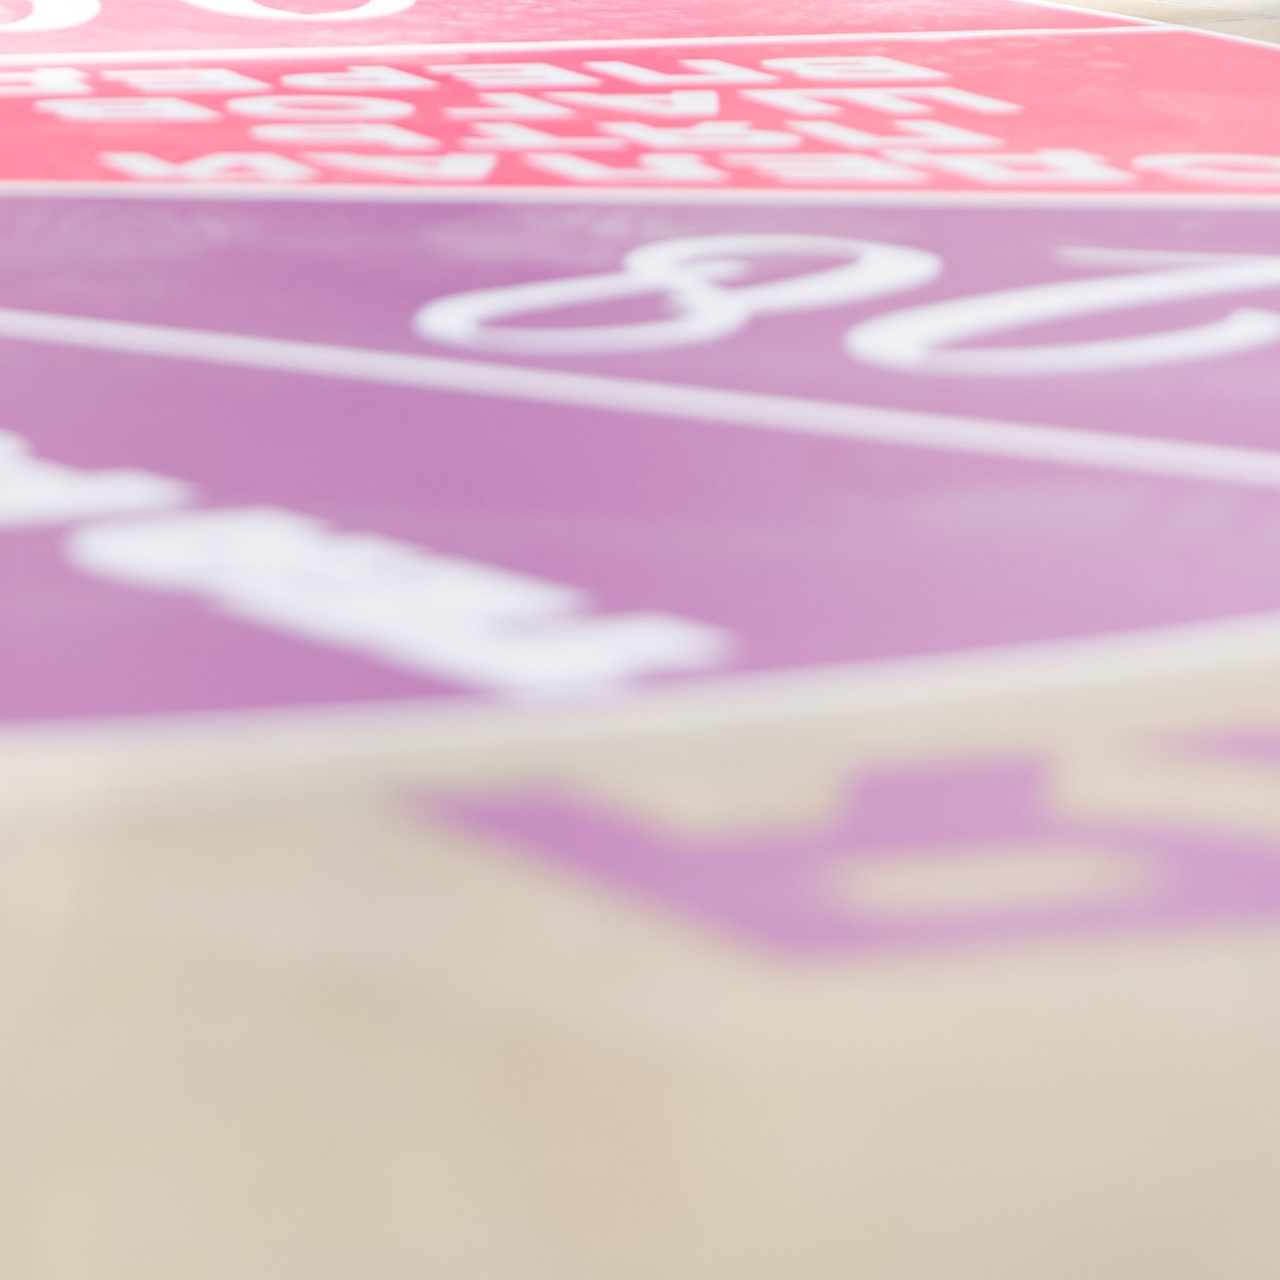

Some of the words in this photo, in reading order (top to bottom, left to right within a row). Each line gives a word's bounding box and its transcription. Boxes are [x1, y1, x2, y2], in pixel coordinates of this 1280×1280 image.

[33, 86, 1021, 122] ШАГОВ
[248, 119, 1005, 152] ПЯТЬ
[96, 148, 1280, 188] СДЕЛАЙ
[413, 233, 1280, 378] 28
